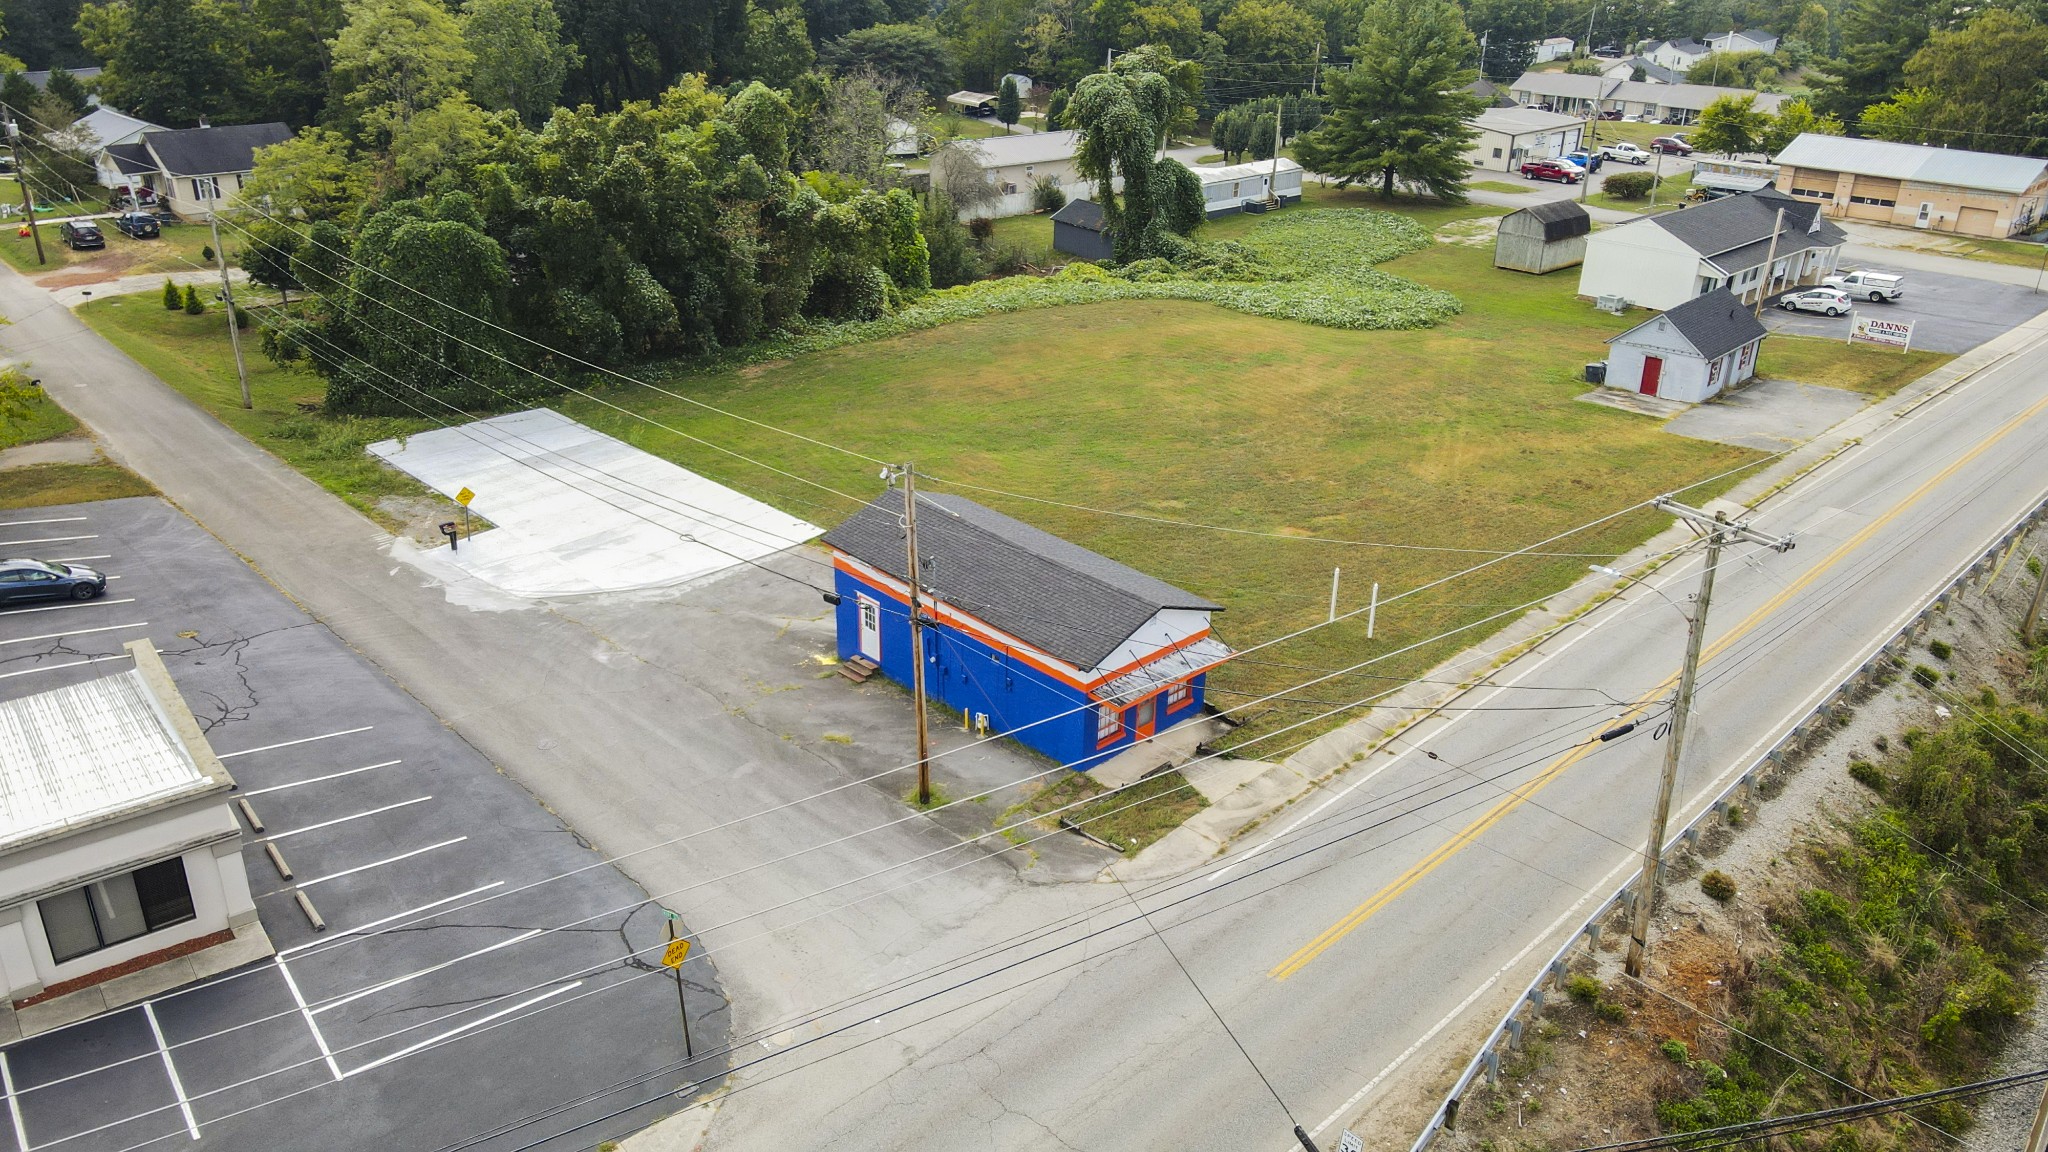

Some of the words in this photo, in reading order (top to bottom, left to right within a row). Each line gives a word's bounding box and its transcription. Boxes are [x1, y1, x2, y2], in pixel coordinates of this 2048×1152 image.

[1870, 320, 1909, 333] DANNS
[667, 942, 684, 958] DEAD
[671, 951, 683, 964] END
[1344, 1131, 1362, 1146] SPEED
[1344, 1138, 1359, 1150] LIMIT
[1340, 1142, 1357, 1152] 3
